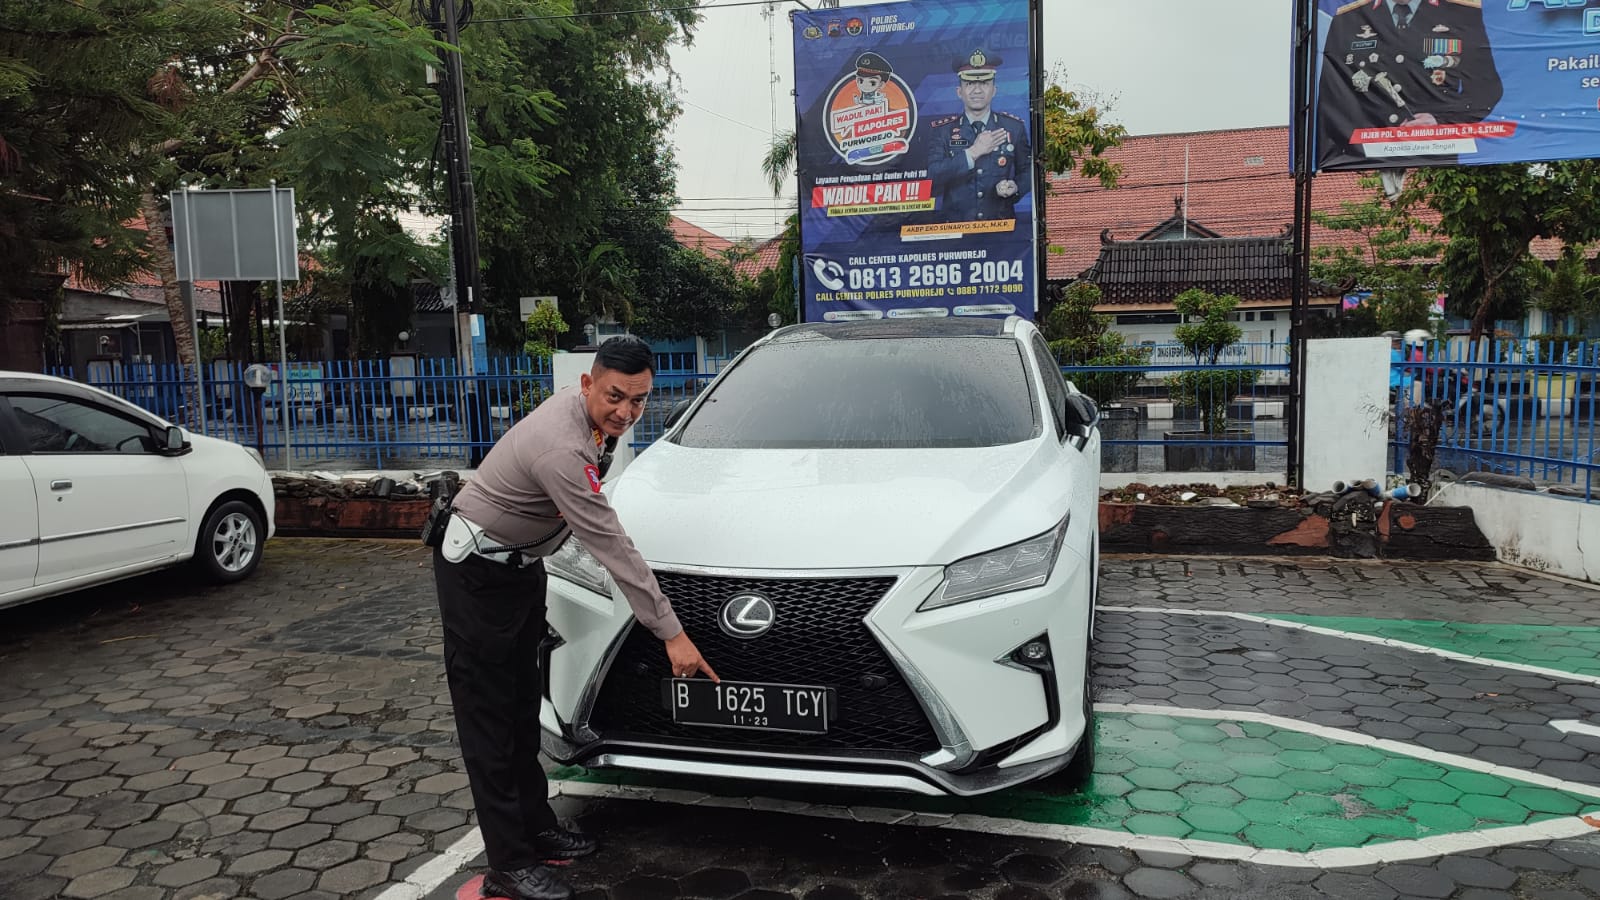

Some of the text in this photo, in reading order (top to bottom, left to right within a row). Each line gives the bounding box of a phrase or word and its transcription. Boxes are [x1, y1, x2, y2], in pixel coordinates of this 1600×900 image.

[871, 15, 898, 25] POLRES
[871, 22, 915, 33] PURWOREJO
[837, 106, 883, 123] WADUL PAK!
[858, 116, 903, 133] KAPOLRES
[843, 132, 892, 147] PURWOREJO
[1381, 130, 1395, 138] POL.
[1411, 129, 1434, 137] AHMAD
[823, 182, 920, 205] WADUL PAK !!!
[849, 250, 986, 265] CALL CENTER KAPOLRES PURWOREJO
[849, 260, 1023, 289] 0813 2696 2004
[816, 292, 833, 301] CALL
[836, 291, 863, 300] CENTER
[866, 290, 893, 299] POLRES
[896, 287, 944, 298] PURWOREJO
[980, 285, 999, 294] 7172
[677, 683, 822, 717] B 1625 TCY
